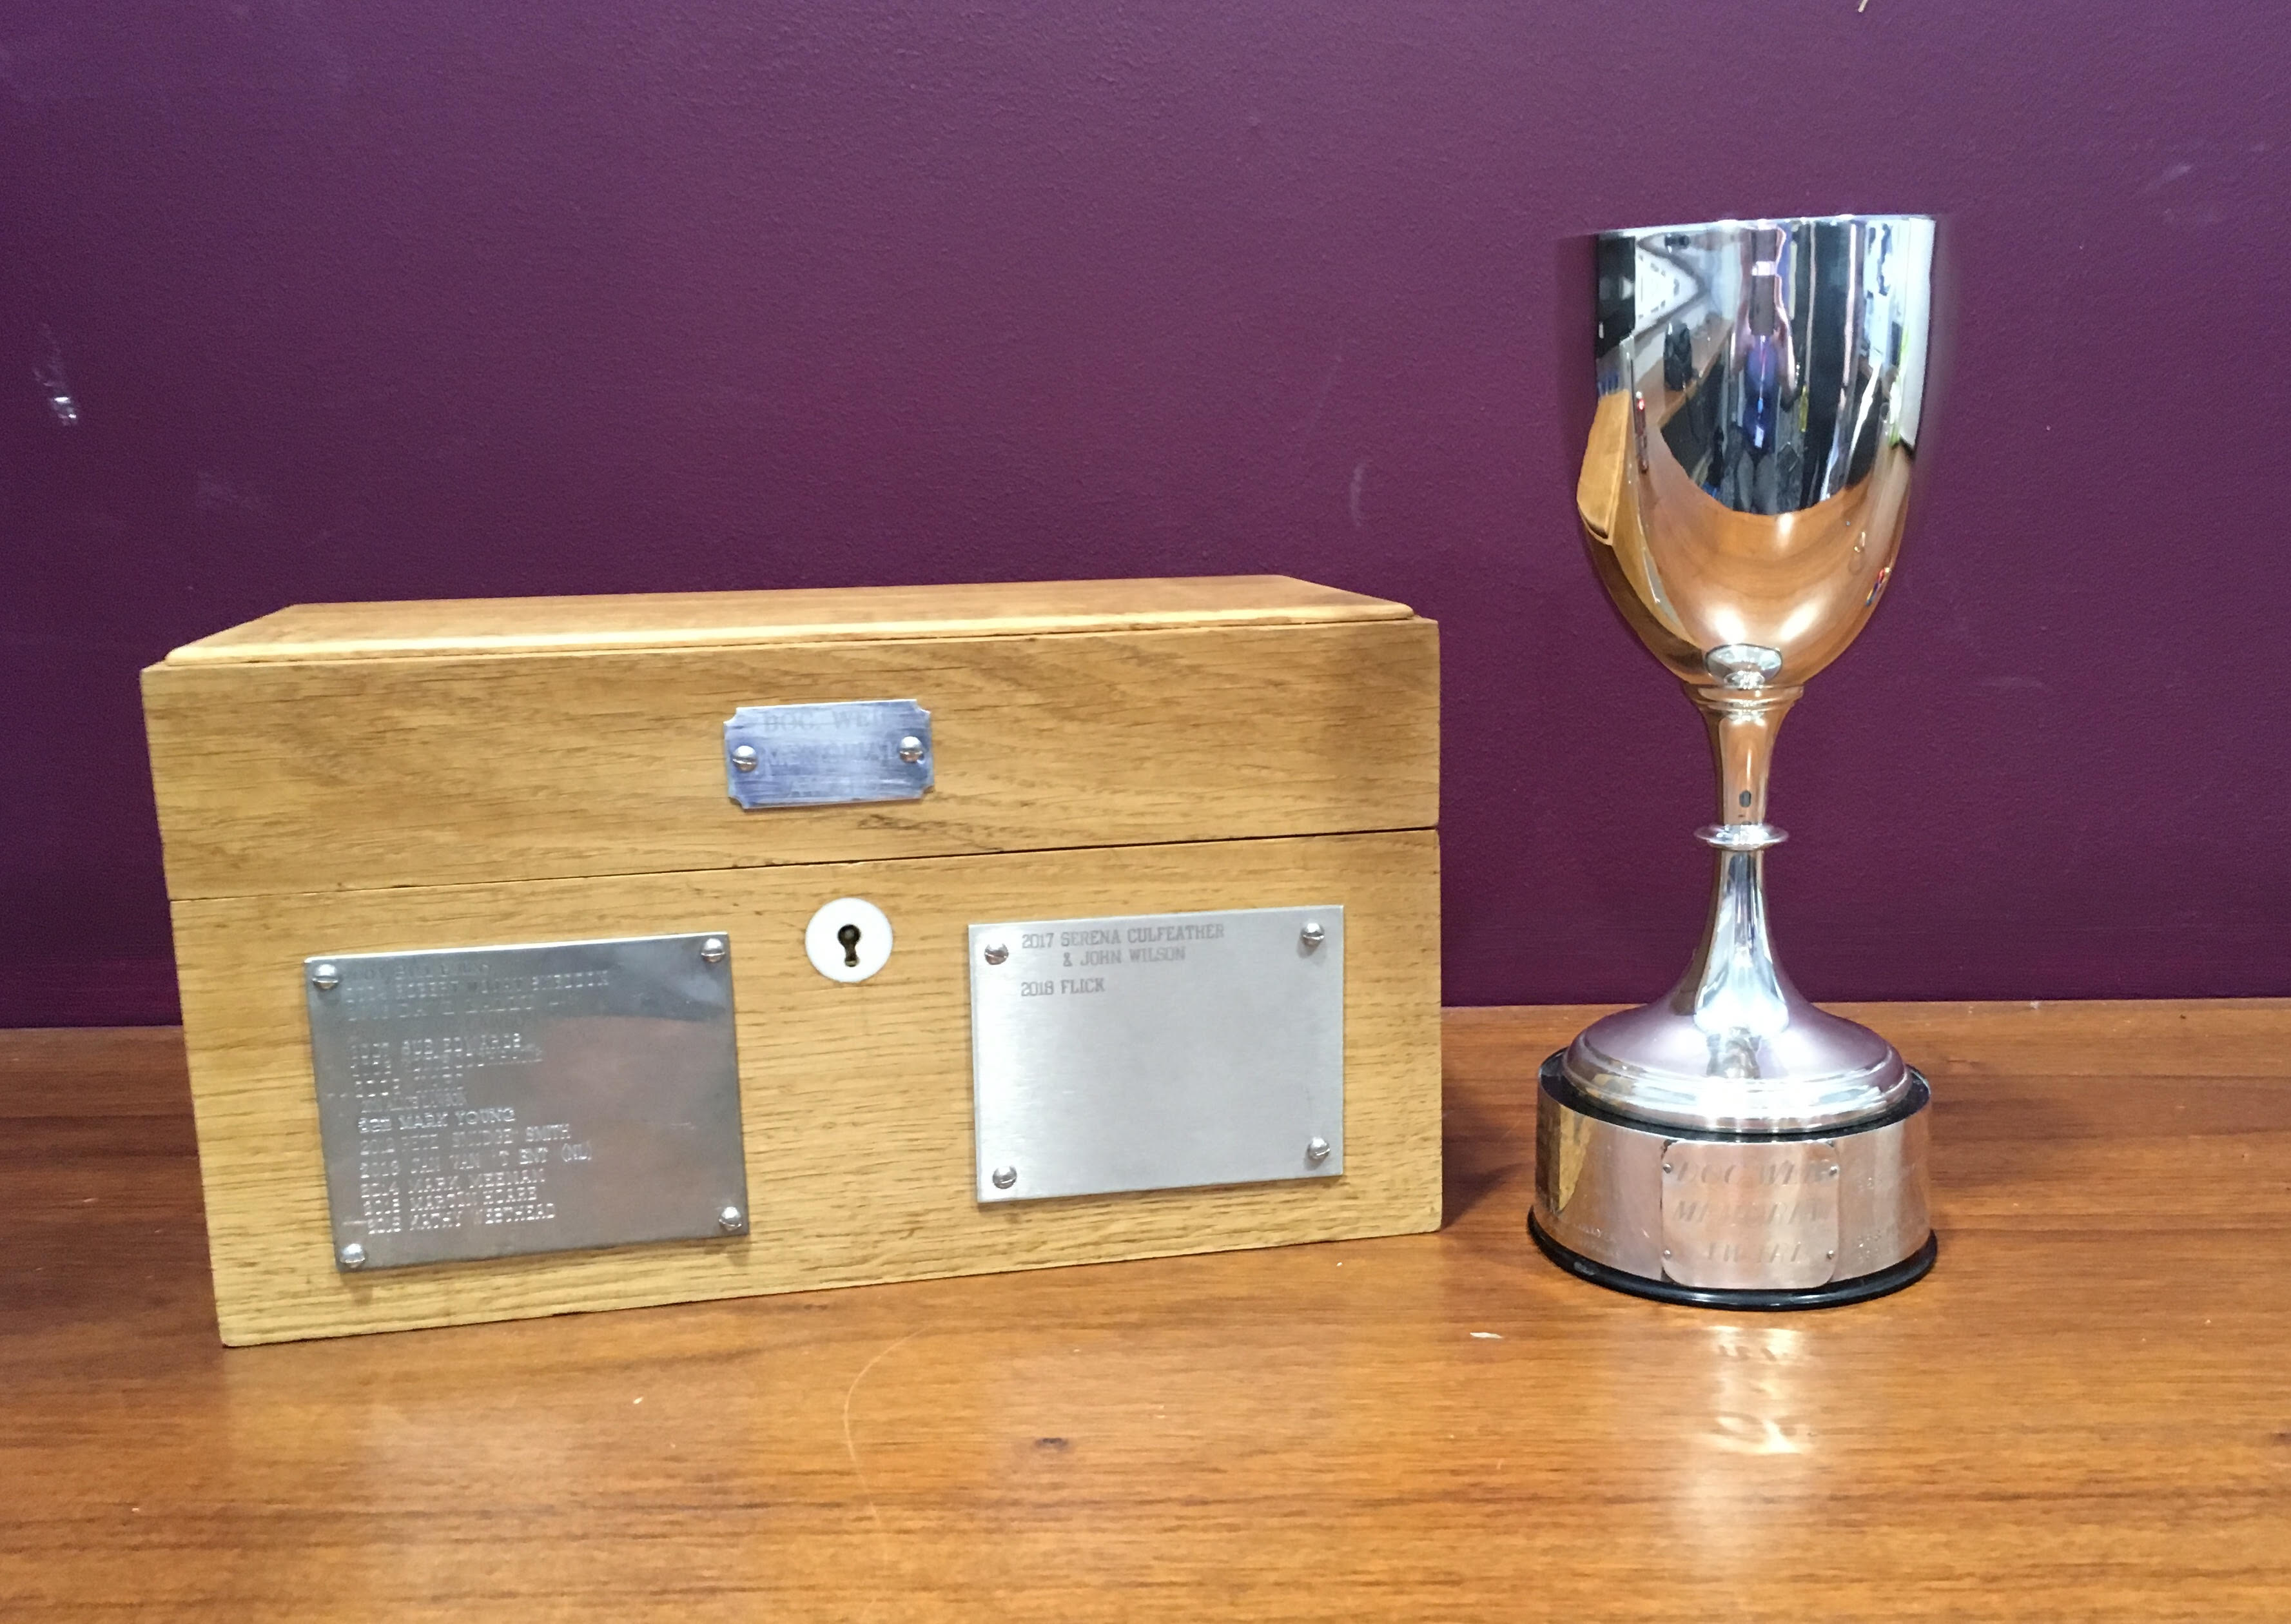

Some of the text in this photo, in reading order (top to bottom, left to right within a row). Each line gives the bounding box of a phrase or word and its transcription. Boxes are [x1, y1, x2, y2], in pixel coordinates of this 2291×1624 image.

[1022, 923, 1225, 949] 2017 SERENA CULFEATHER
[1063, 946, 1187, 967] & JOHN WILSON
[1020, 977, 1106, 997] 2018 FLICK
[398, 1112, 449, 1130] MARK
[455, 1107, 516, 1127] YOUNG
